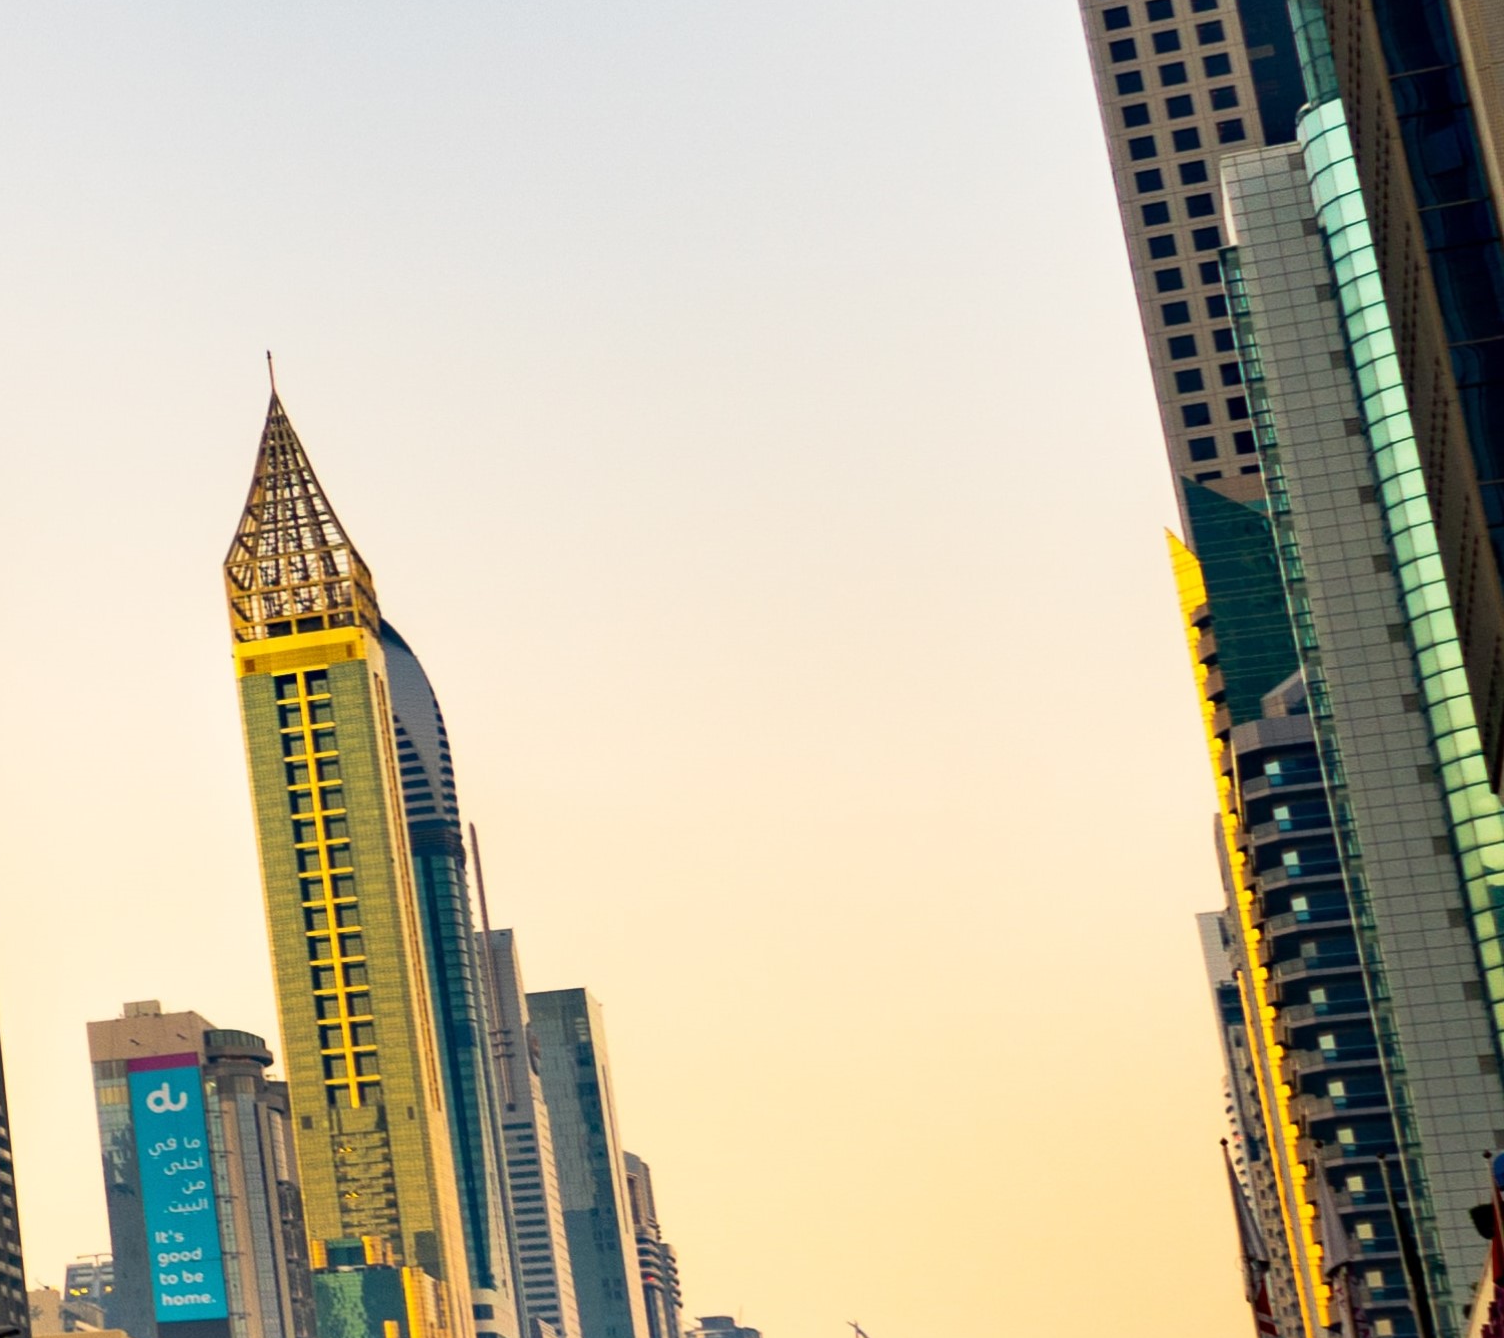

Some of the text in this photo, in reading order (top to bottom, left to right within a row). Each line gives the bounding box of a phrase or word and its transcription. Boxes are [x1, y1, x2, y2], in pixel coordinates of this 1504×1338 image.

[146, 1082, 188, 1113] du
[157, 1247, 203, 1268] good
[159, 1269, 204, 1286] to be
[161, 1293, 217, 1307] home.
